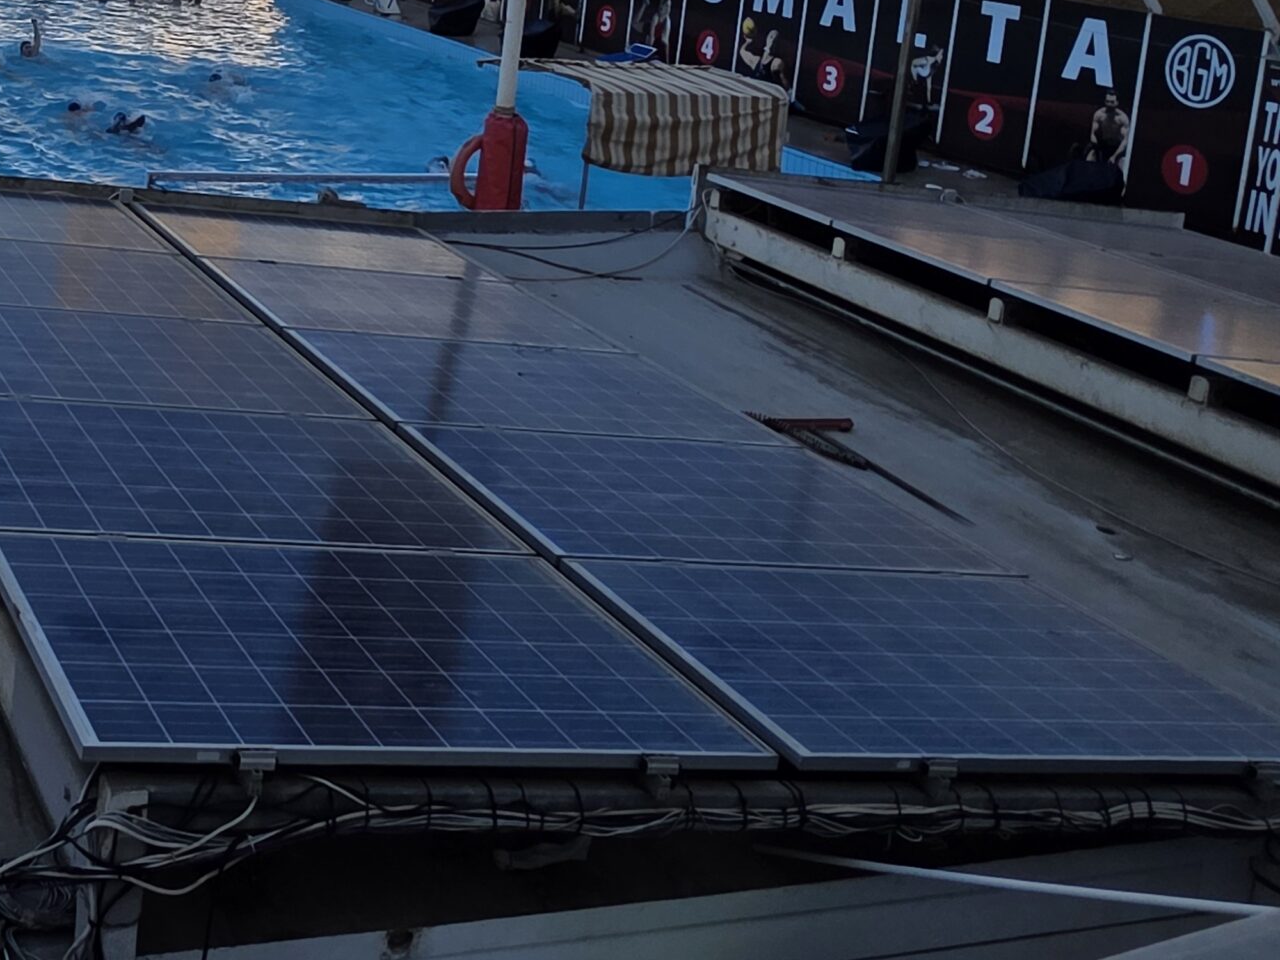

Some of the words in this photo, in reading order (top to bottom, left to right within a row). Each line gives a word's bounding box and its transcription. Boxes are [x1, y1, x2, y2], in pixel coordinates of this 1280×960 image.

[600, 10, 612, 32] 5
[701, 36, 714, 59] 4
[822, 65, 838, 92] 3
[1172, 42, 1230, 103] BGM
[974, 103, 995, 134] 2
[1175, 153, 1193, 187] 1
